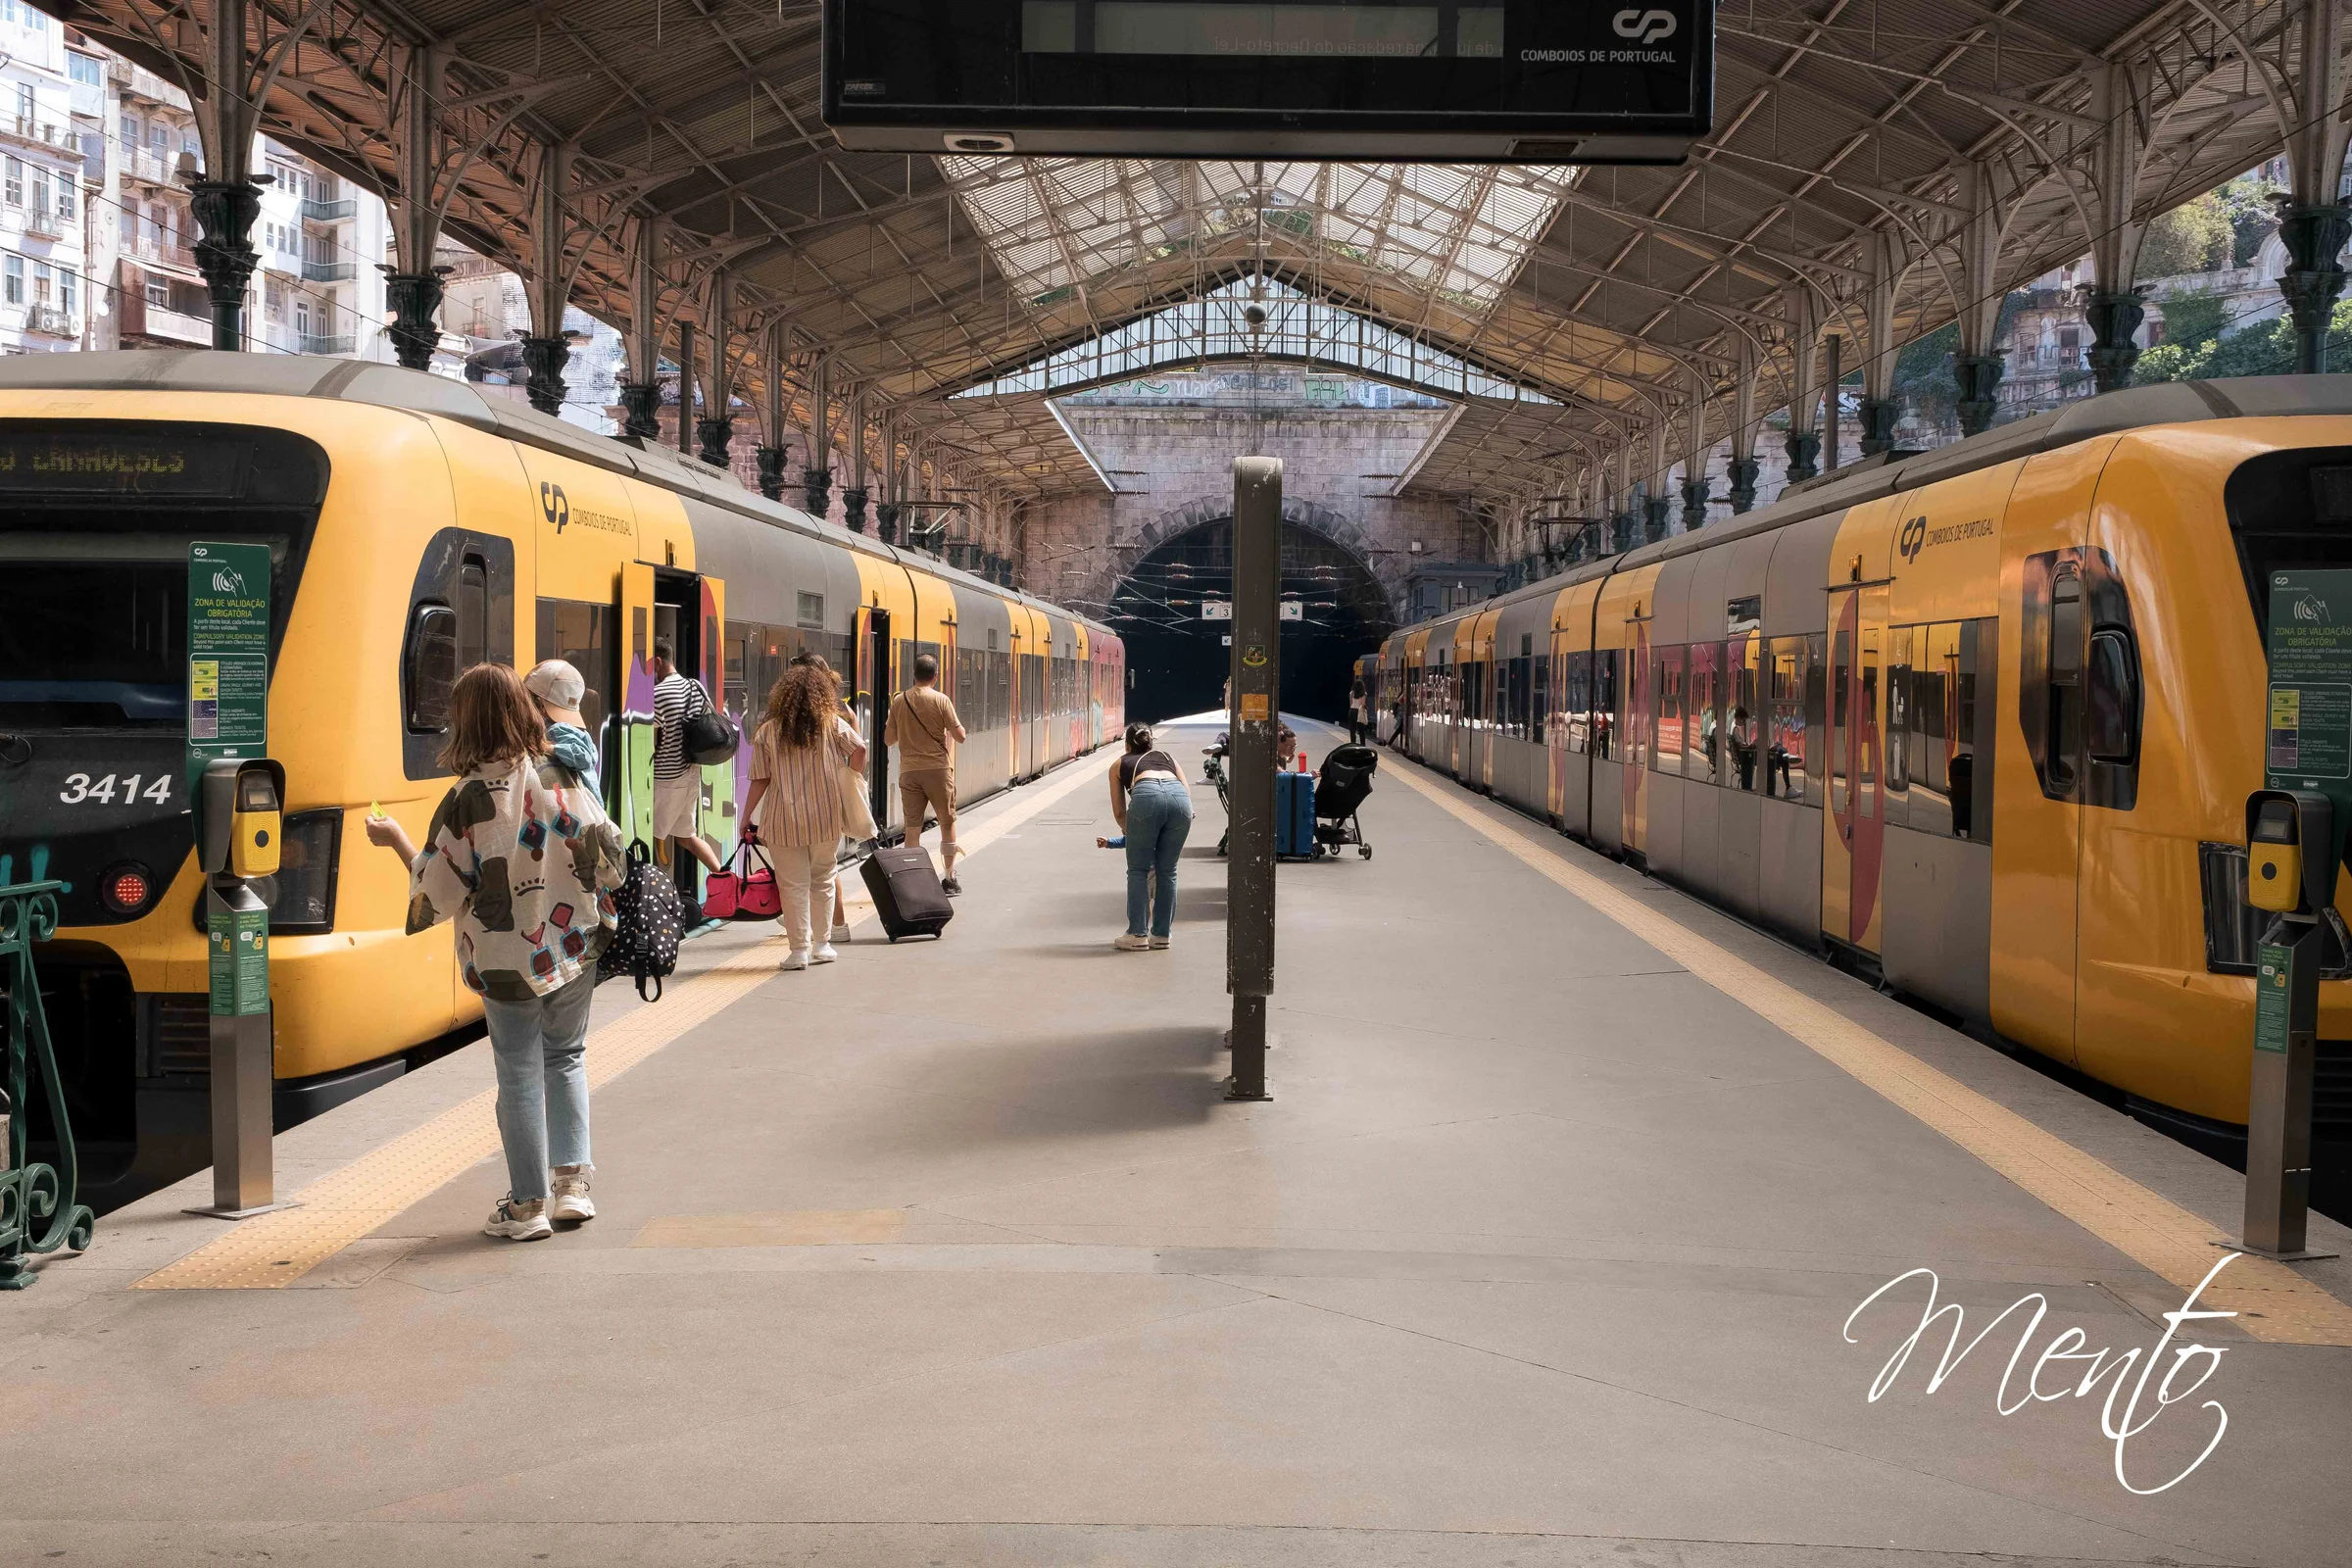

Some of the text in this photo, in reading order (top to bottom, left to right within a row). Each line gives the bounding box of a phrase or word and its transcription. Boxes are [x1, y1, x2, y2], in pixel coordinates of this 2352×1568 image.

[1521, 50, 1677, 63] COMBOIOS DE PORTUGAL
[572, 508, 600, 529] COMBOIOS
[607, 516, 632, 536] PORTUGAL
[1926, 526, 1954, 547] COMBOIOS
[1963, 517, 1994, 540] PORTUGAL
[195, 598, 214, 607] ZONA
[227, 599, 266, 609] VALIDAÇÃO
[208, 609, 252, 617] OBRIGATÓRIA
[1223, 609, 1229, 617] 3
[2275, 625, 2352, 636] ZONA DE VALIDAÇÃO
[2287, 636, 2337, 646] OBRIGATÓRIA
[60, 773, 172, 805] 3414
